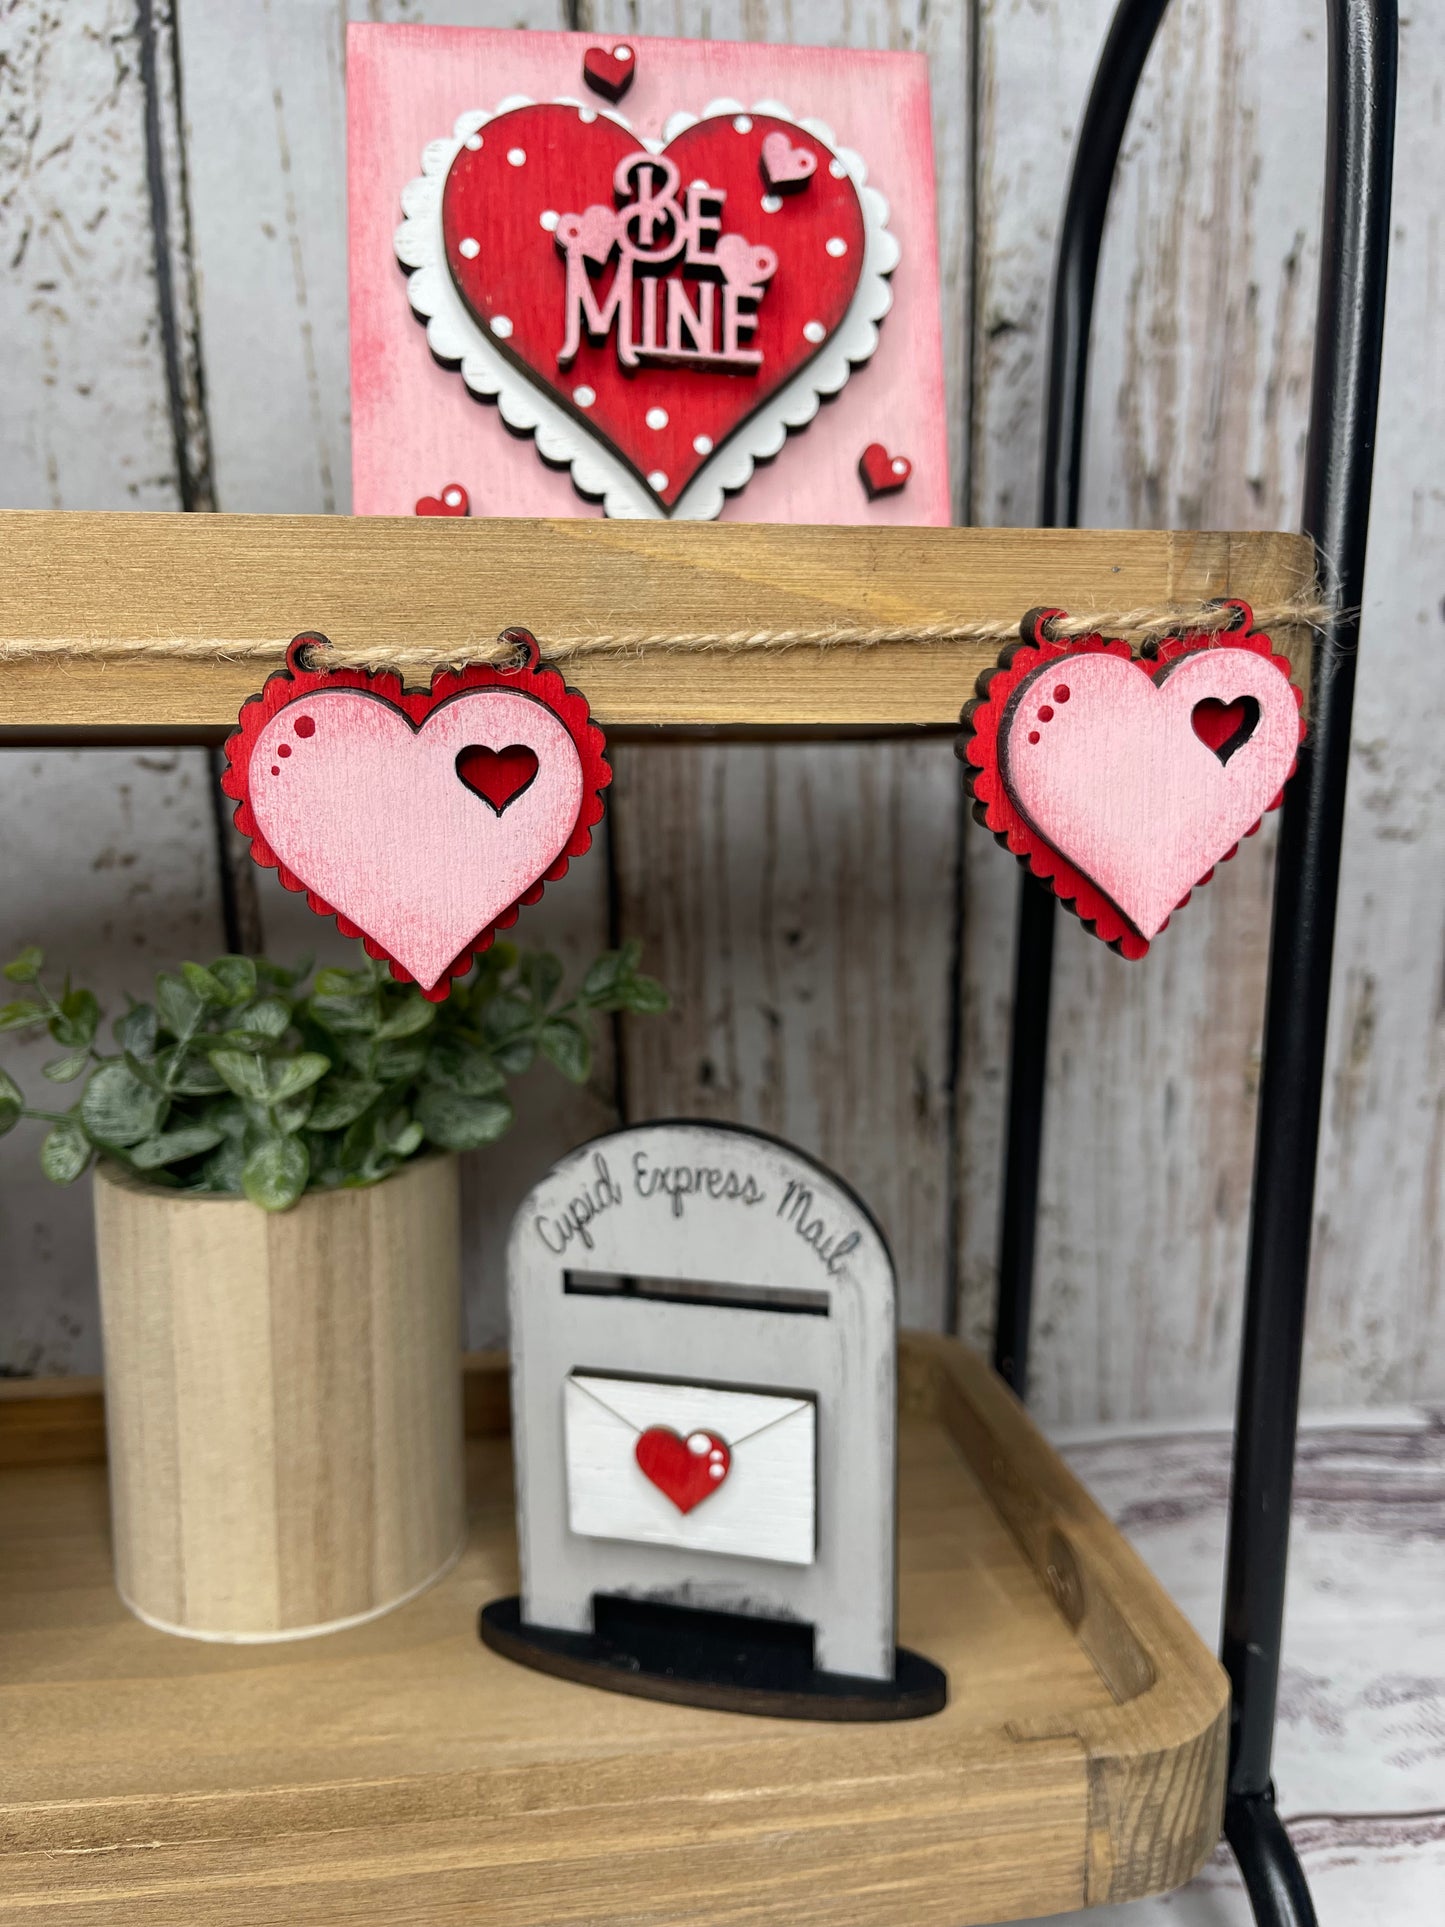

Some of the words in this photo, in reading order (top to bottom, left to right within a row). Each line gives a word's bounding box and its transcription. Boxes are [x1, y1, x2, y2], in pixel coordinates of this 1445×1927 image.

[614, 151, 727, 265] BE
[557, 247, 765, 366] MINE
[535, 1151, 622, 1254] Cupid
[631, 1151, 767, 1218] Express
[776, 1178, 863, 1276] Mail
